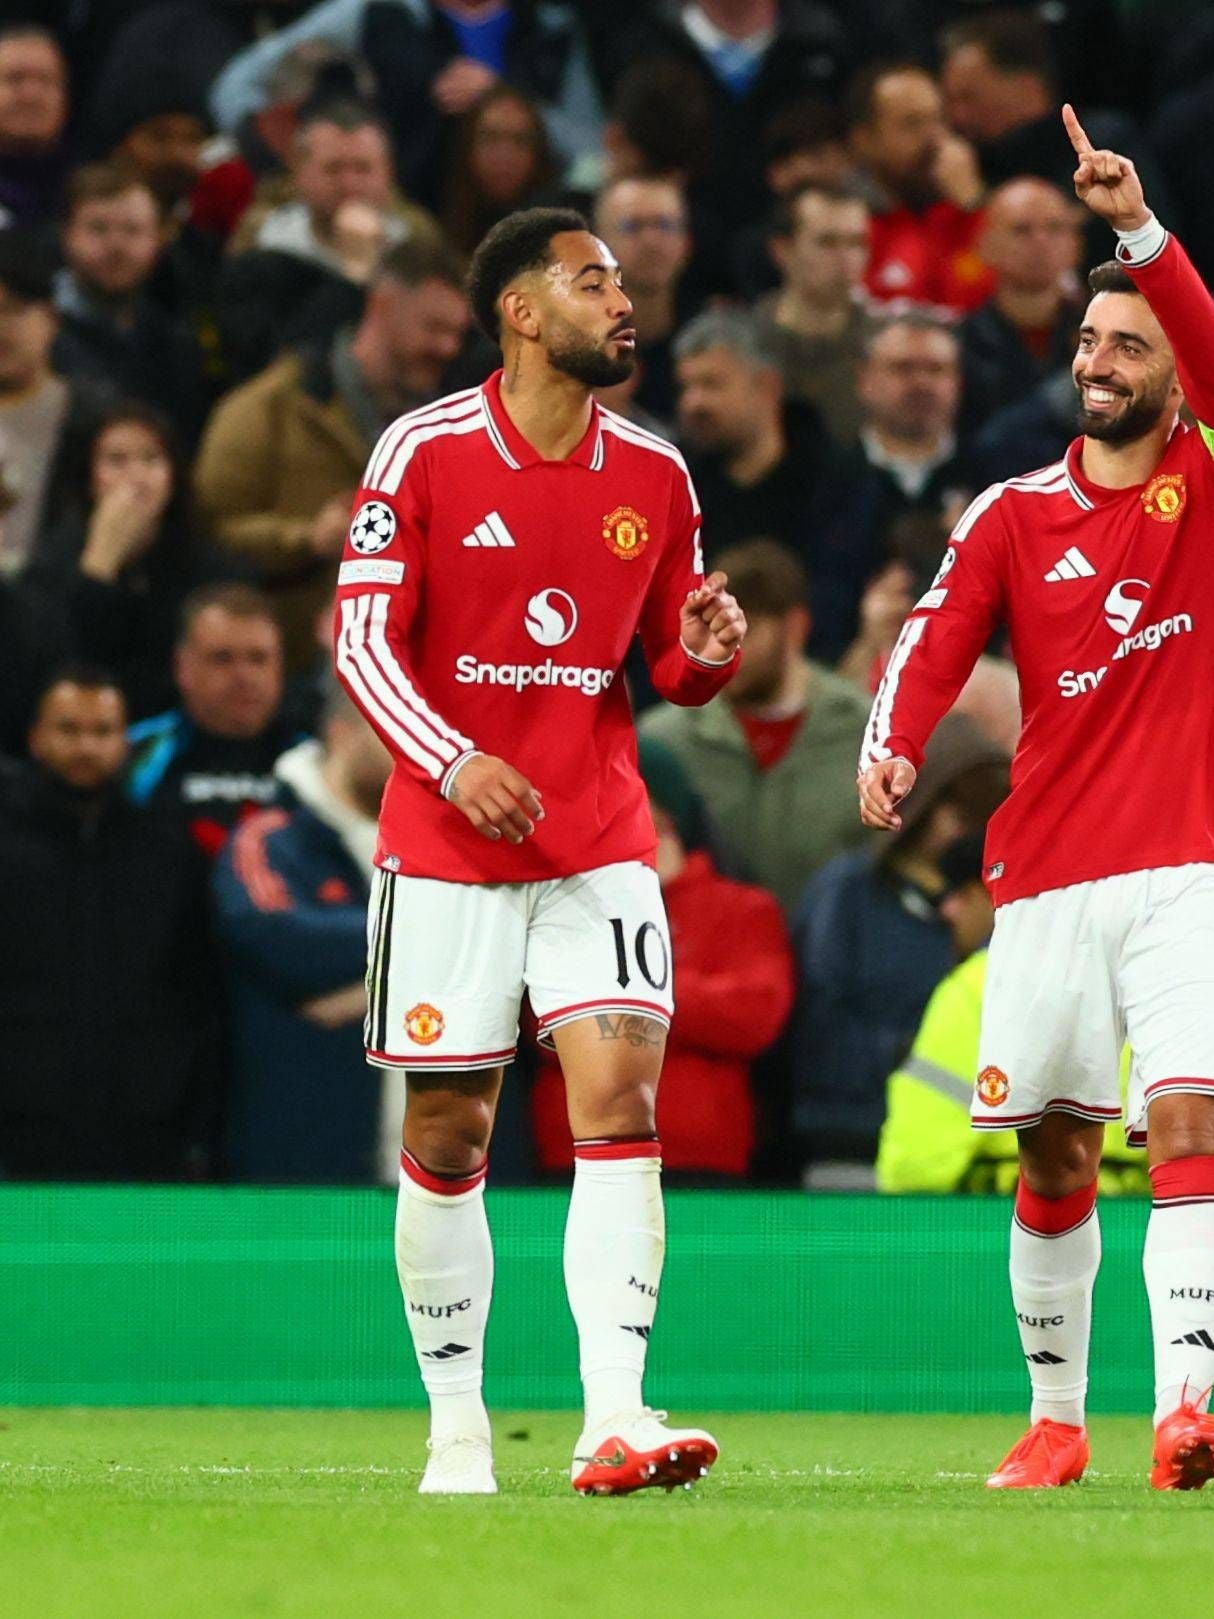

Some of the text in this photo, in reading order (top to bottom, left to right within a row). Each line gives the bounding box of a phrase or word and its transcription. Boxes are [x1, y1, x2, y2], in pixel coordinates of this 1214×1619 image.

[455, 655, 614, 696] Snapdrago
[608, 918, 668, 991] 10
[629, 1276, 658, 1297] MU
[409, 1298, 471, 1318] MUFC
